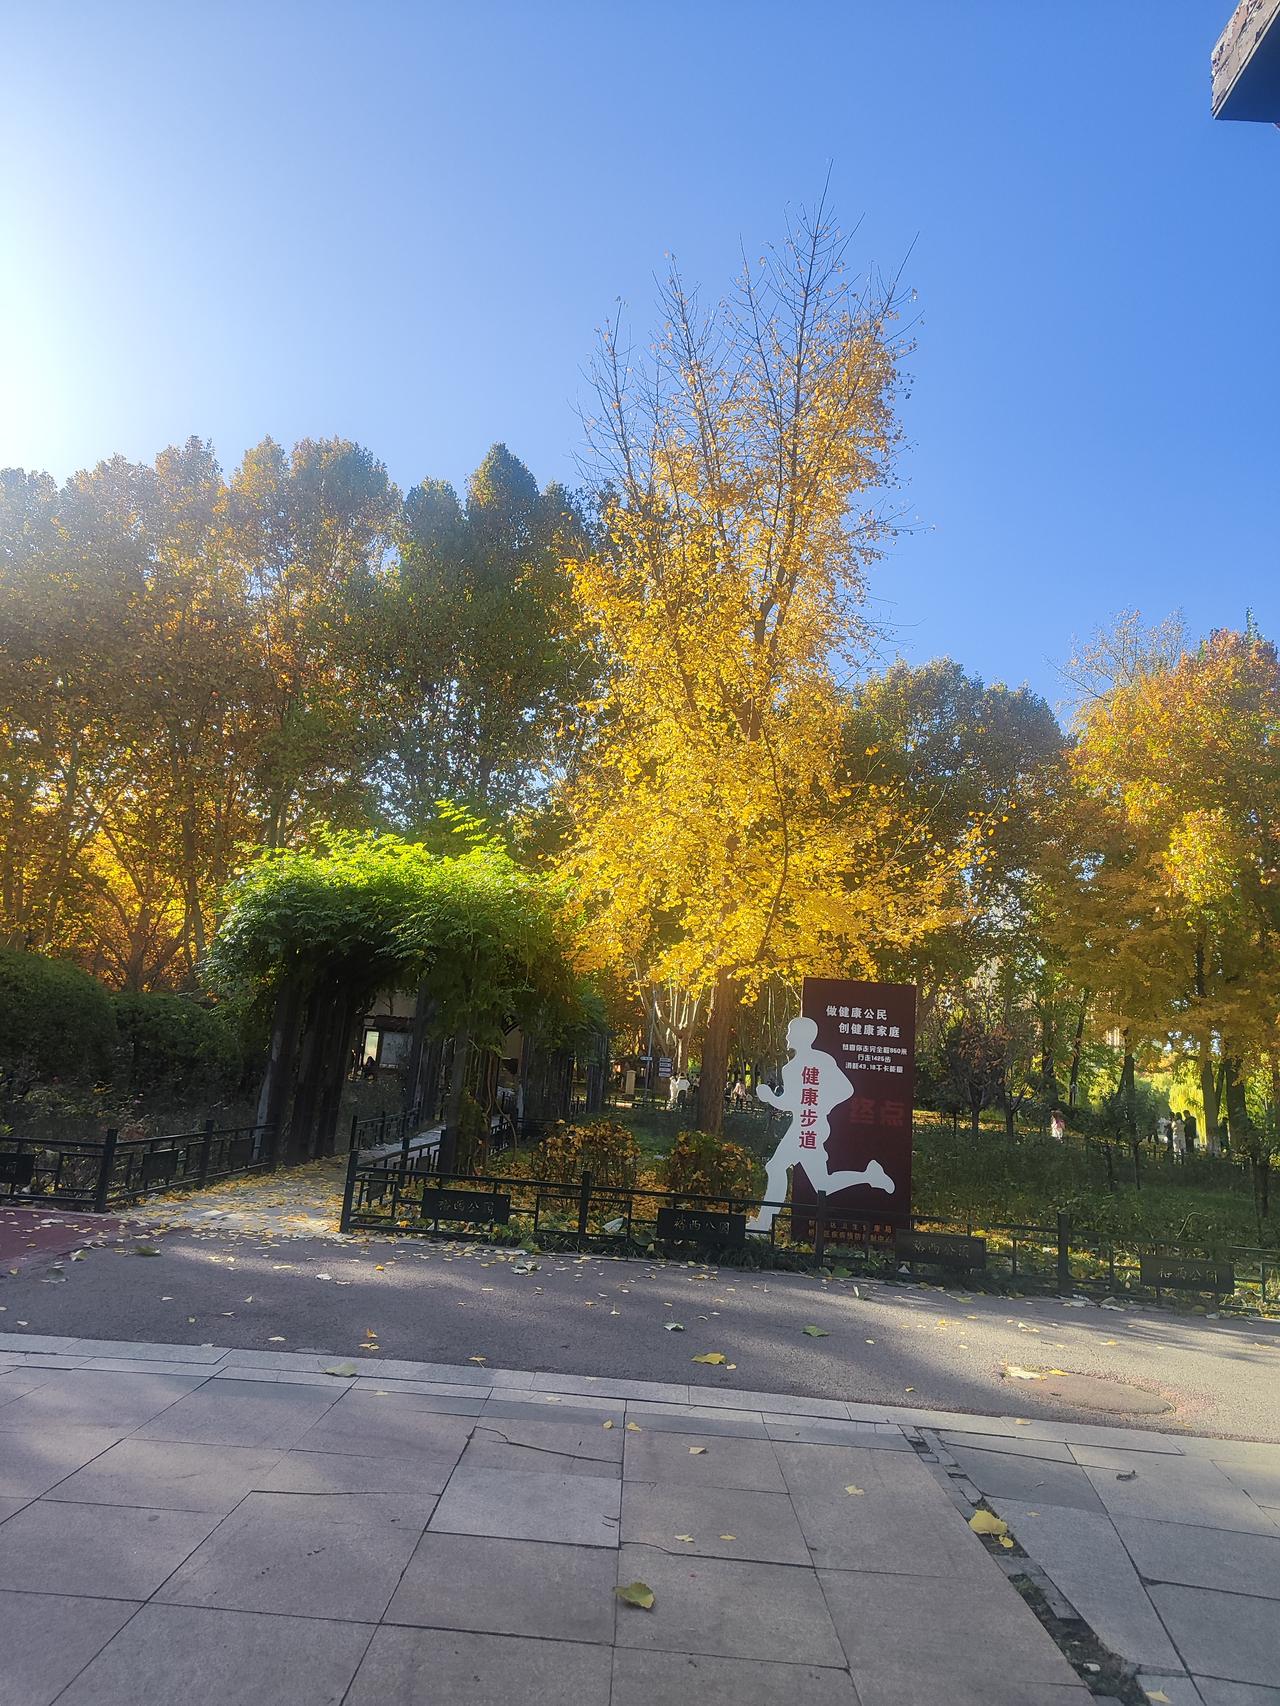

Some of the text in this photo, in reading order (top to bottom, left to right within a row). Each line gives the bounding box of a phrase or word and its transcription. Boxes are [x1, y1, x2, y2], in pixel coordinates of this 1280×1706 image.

[826, 1005, 887, 1020] 做健康公民
[838, 1022, 900, 1038] 创健康家庭
[799, 1066, 819, 1150] 健康步道
